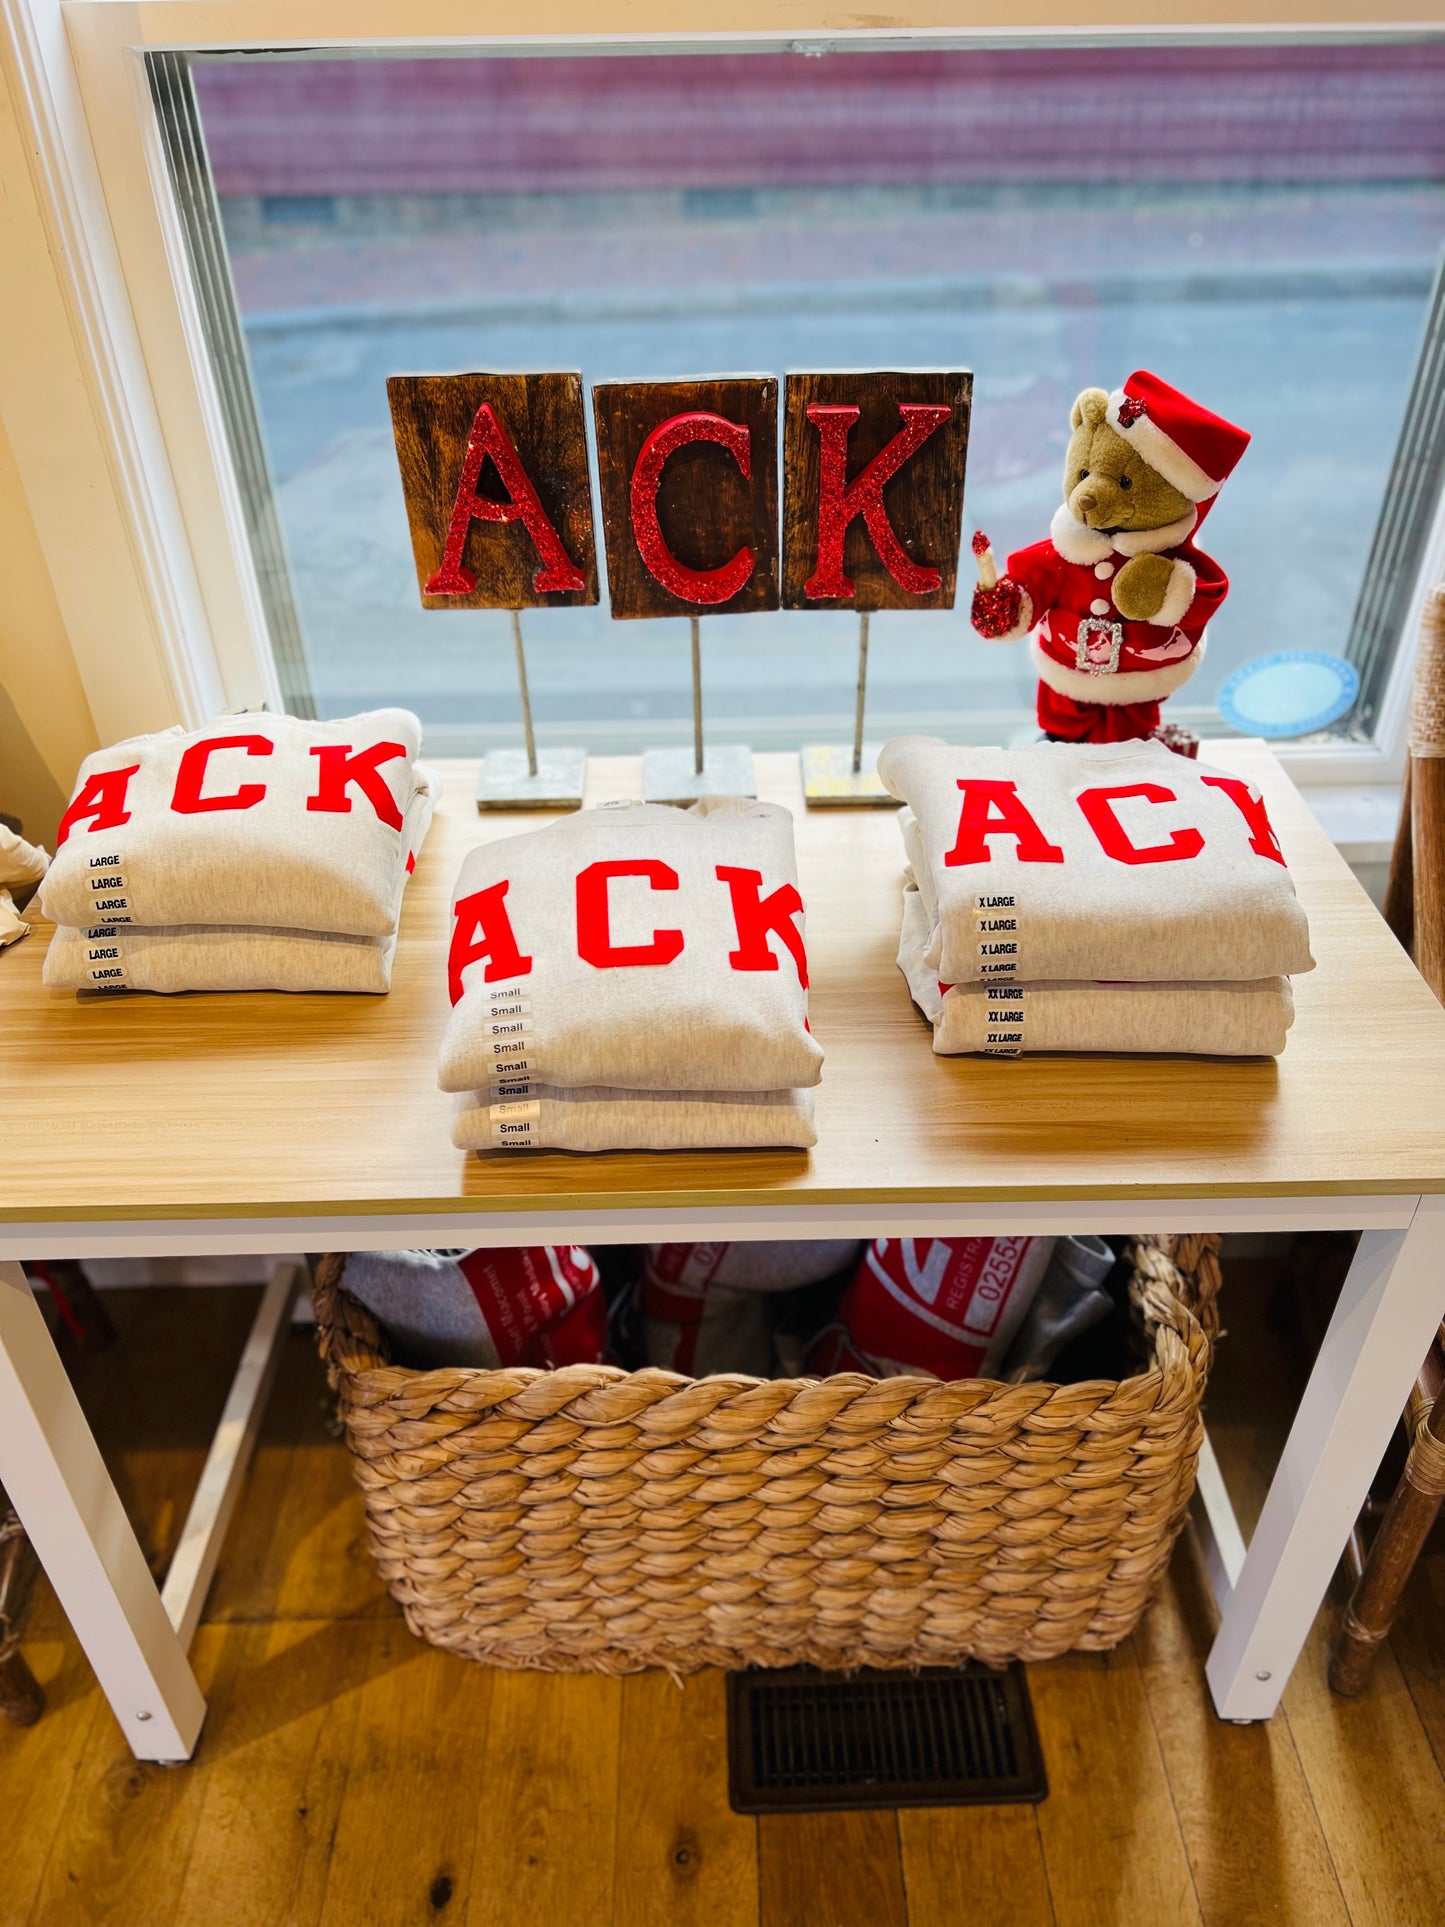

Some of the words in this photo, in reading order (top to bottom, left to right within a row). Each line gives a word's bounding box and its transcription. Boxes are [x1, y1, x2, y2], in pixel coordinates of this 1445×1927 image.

[423, 401, 952, 605] ACK
[57, 734, 407, 847] ACK
[90, 855, 120, 867] LARGE
[91, 877, 123, 890] LARGE
[95, 899, 127, 910] LARGE
[979, 897, 986, 908] X
[987, 896, 1016, 907] LARGE
[980, 920, 987, 931] X
[988, 919, 1017, 931] LARGE
[88, 927, 117, 939] LARGE
[448, 859, 809, 1008] ACK
[89, 948, 119, 960] LARGE
[981, 944, 988, 955] X
[989, 943, 1018, 954] LARGE
[92, 968, 123, 979] LARGE
[980, 965, 988, 973] X
[988, 963, 1017, 972] LARGE
[490, 988, 520, 1000] Small
[987, 989, 998, 999] XX
[1000, 989, 1023, 999] LARGE
[491, 1005, 522, 1016] Small
[988, 1011, 999, 1022] XX
[1000, 1011, 1024, 1022] LARGE
[492, 1023, 523, 1035] Small
[987, 1034, 998, 1043] XX
[998, 1033, 1023, 1043] LARGE
[493, 1041, 525, 1054] Small
[496, 1061, 527, 1073] Small
[498, 1076, 530, 1084] Small
[498, 1085, 529, 1096] Small
[499, 1103, 529, 1114] Small
[500, 1122, 530, 1133] Small
[501, 1139, 532, 1147] Small
